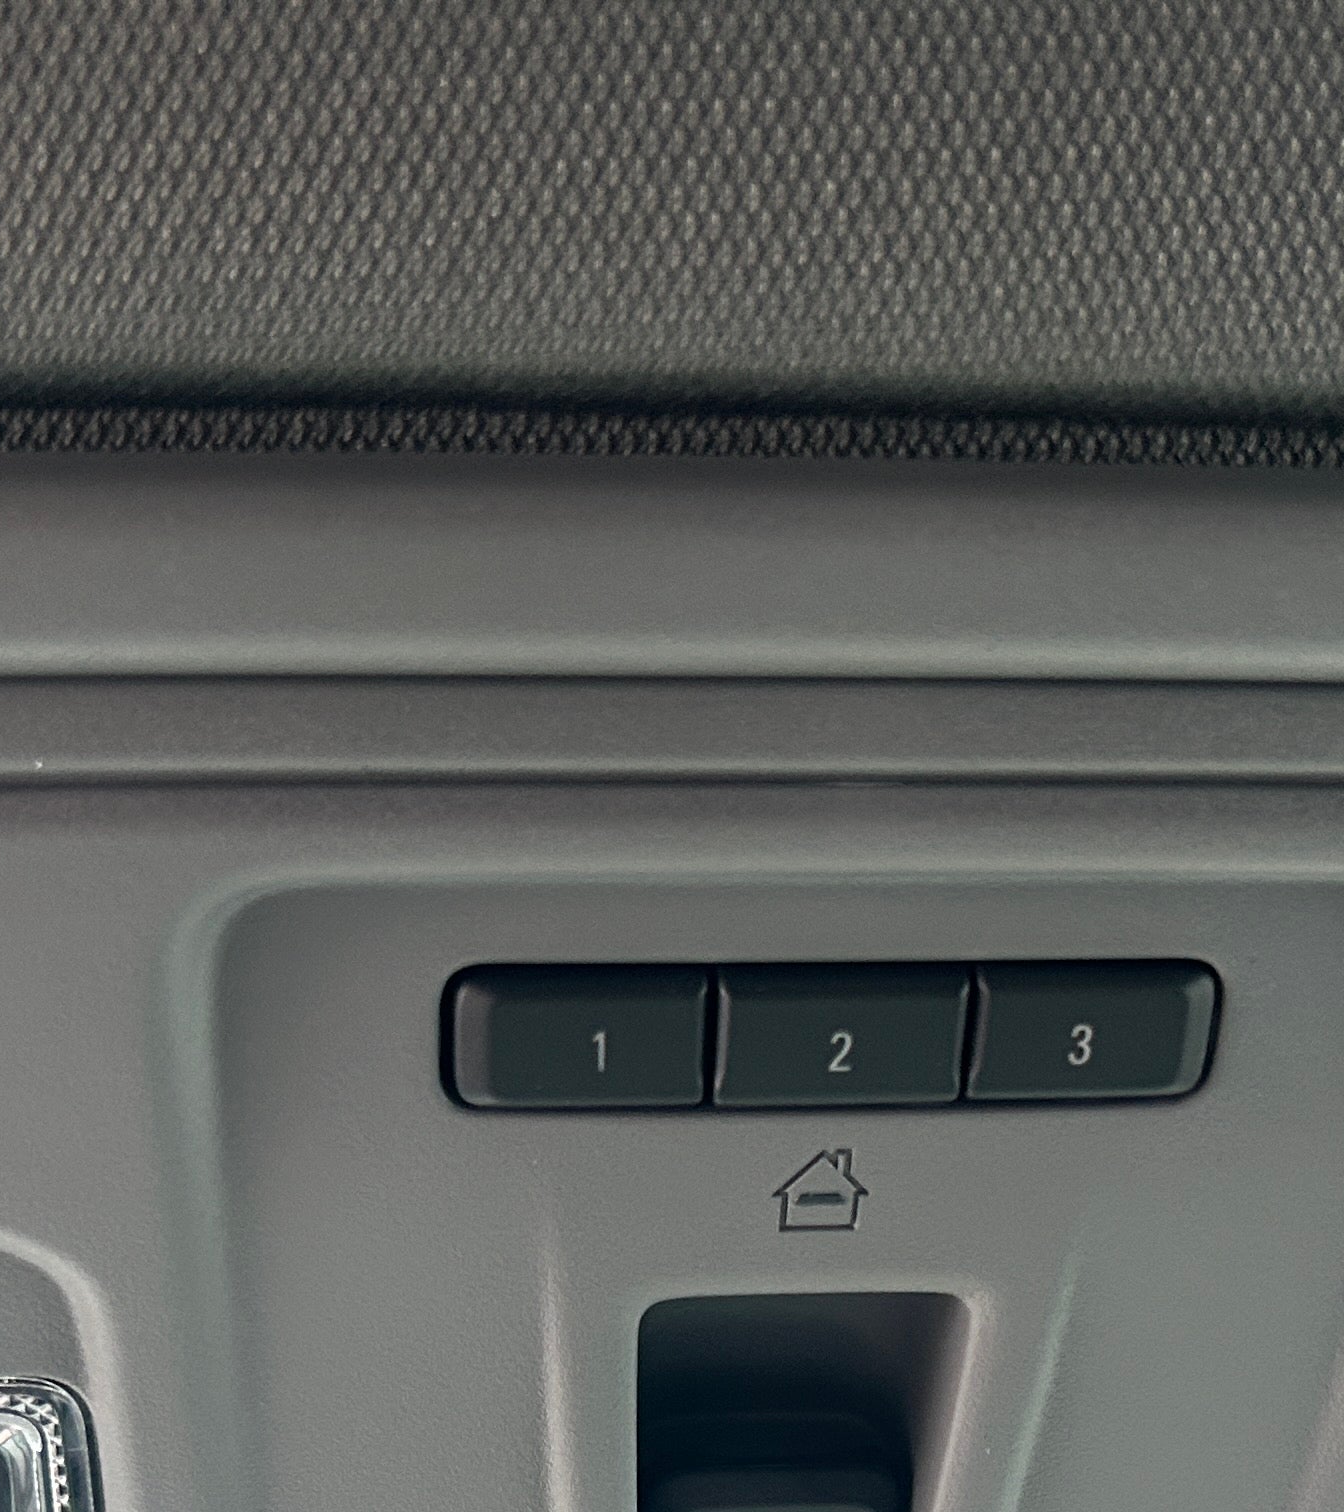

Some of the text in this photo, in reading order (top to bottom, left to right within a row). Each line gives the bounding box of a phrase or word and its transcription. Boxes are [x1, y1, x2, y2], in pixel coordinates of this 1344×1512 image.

[592, 1031, 607, 1073] 1
[829, 1031, 853, 1073] 2
[1068, 1024, 1093, 1066] 3
